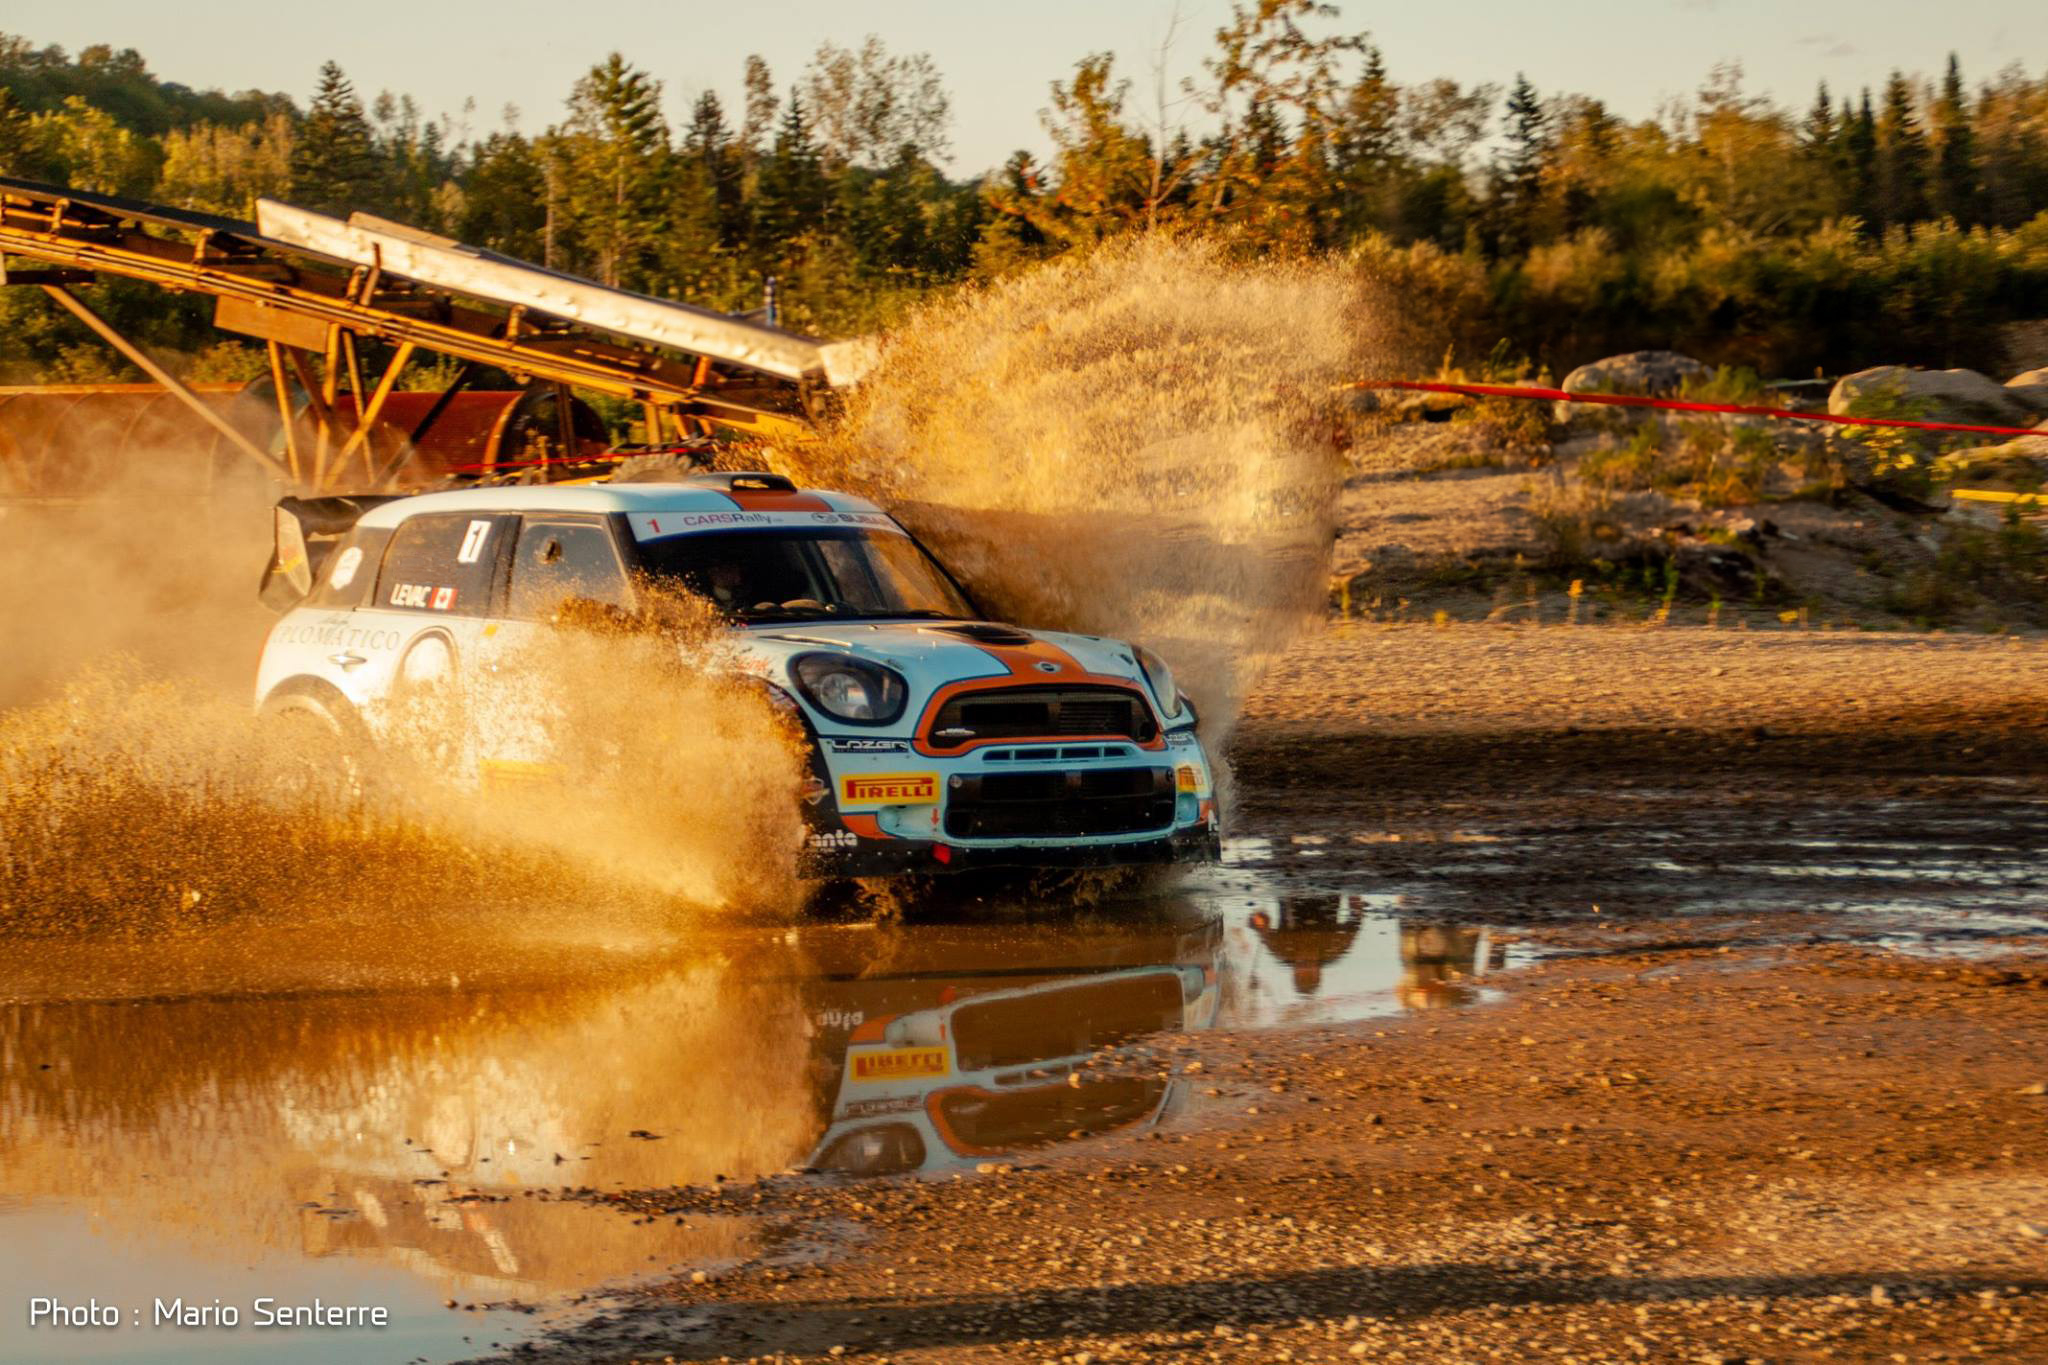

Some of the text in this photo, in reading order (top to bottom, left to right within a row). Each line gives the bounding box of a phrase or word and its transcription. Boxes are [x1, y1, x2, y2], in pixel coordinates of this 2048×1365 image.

[646, 518, 661, 533] 1
[390, 583, 432, 608] LEVAC
[846, 777, 934, 799] PIRELLI
